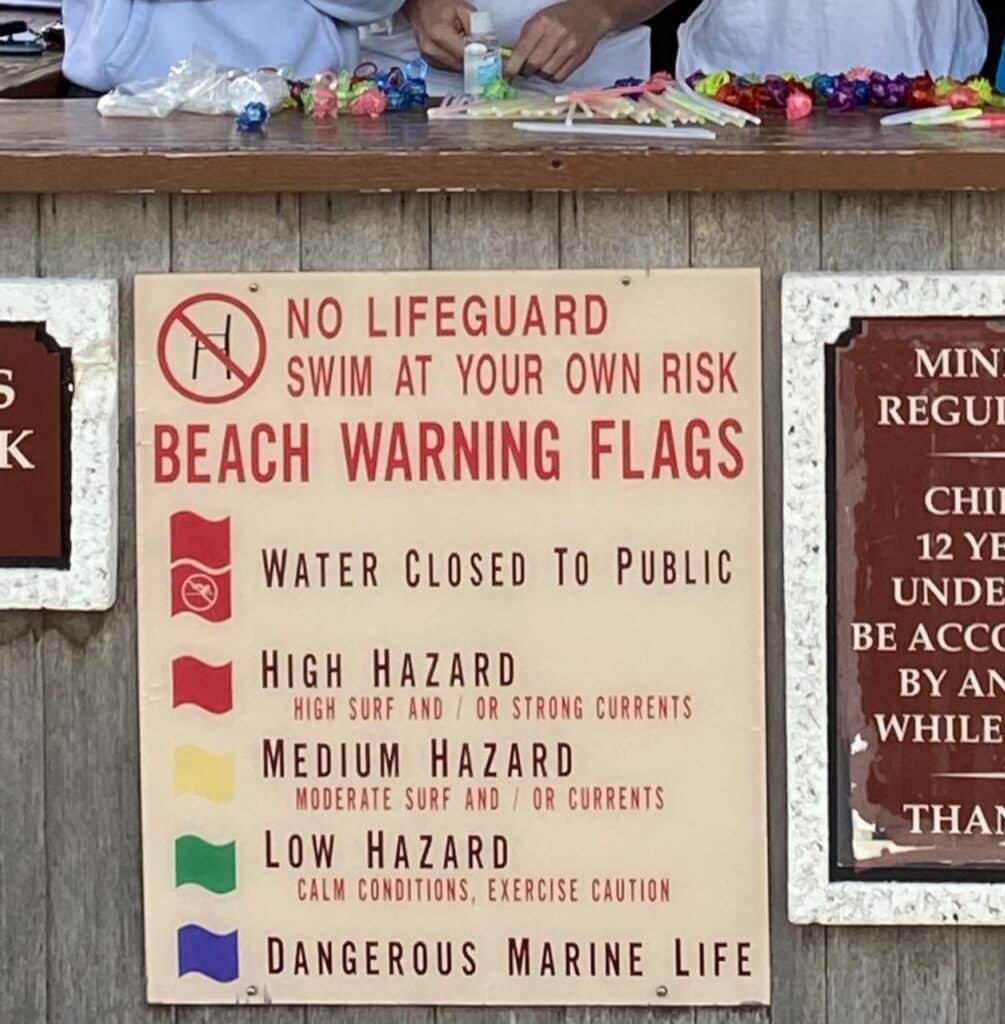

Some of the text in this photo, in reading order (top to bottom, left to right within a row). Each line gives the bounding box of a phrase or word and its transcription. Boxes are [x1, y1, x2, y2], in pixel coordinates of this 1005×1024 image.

[287, 294, 608, 340] NO LIFEGUARD
[287, 351, 738, 398] SWIM AT YOUR OWN RISK
[154, 418, 744, 484] BEACH WARNING FLAGS
[917, 533, 954, 560] 12
[850, 622, 897, 651] BE
[898, 668, 947, 697] BY
[294, 695, 692, 721] HIGH SURF AND / OR STRONG CURRENTS
[874, 714, 1003, 743] WHILE
[295, 785, 664, 811] MODERATE SURF AND / OR CURRENTS
[297, 877, 670, 905] CALM CONDITIONS, EXERCISE CAUTION
